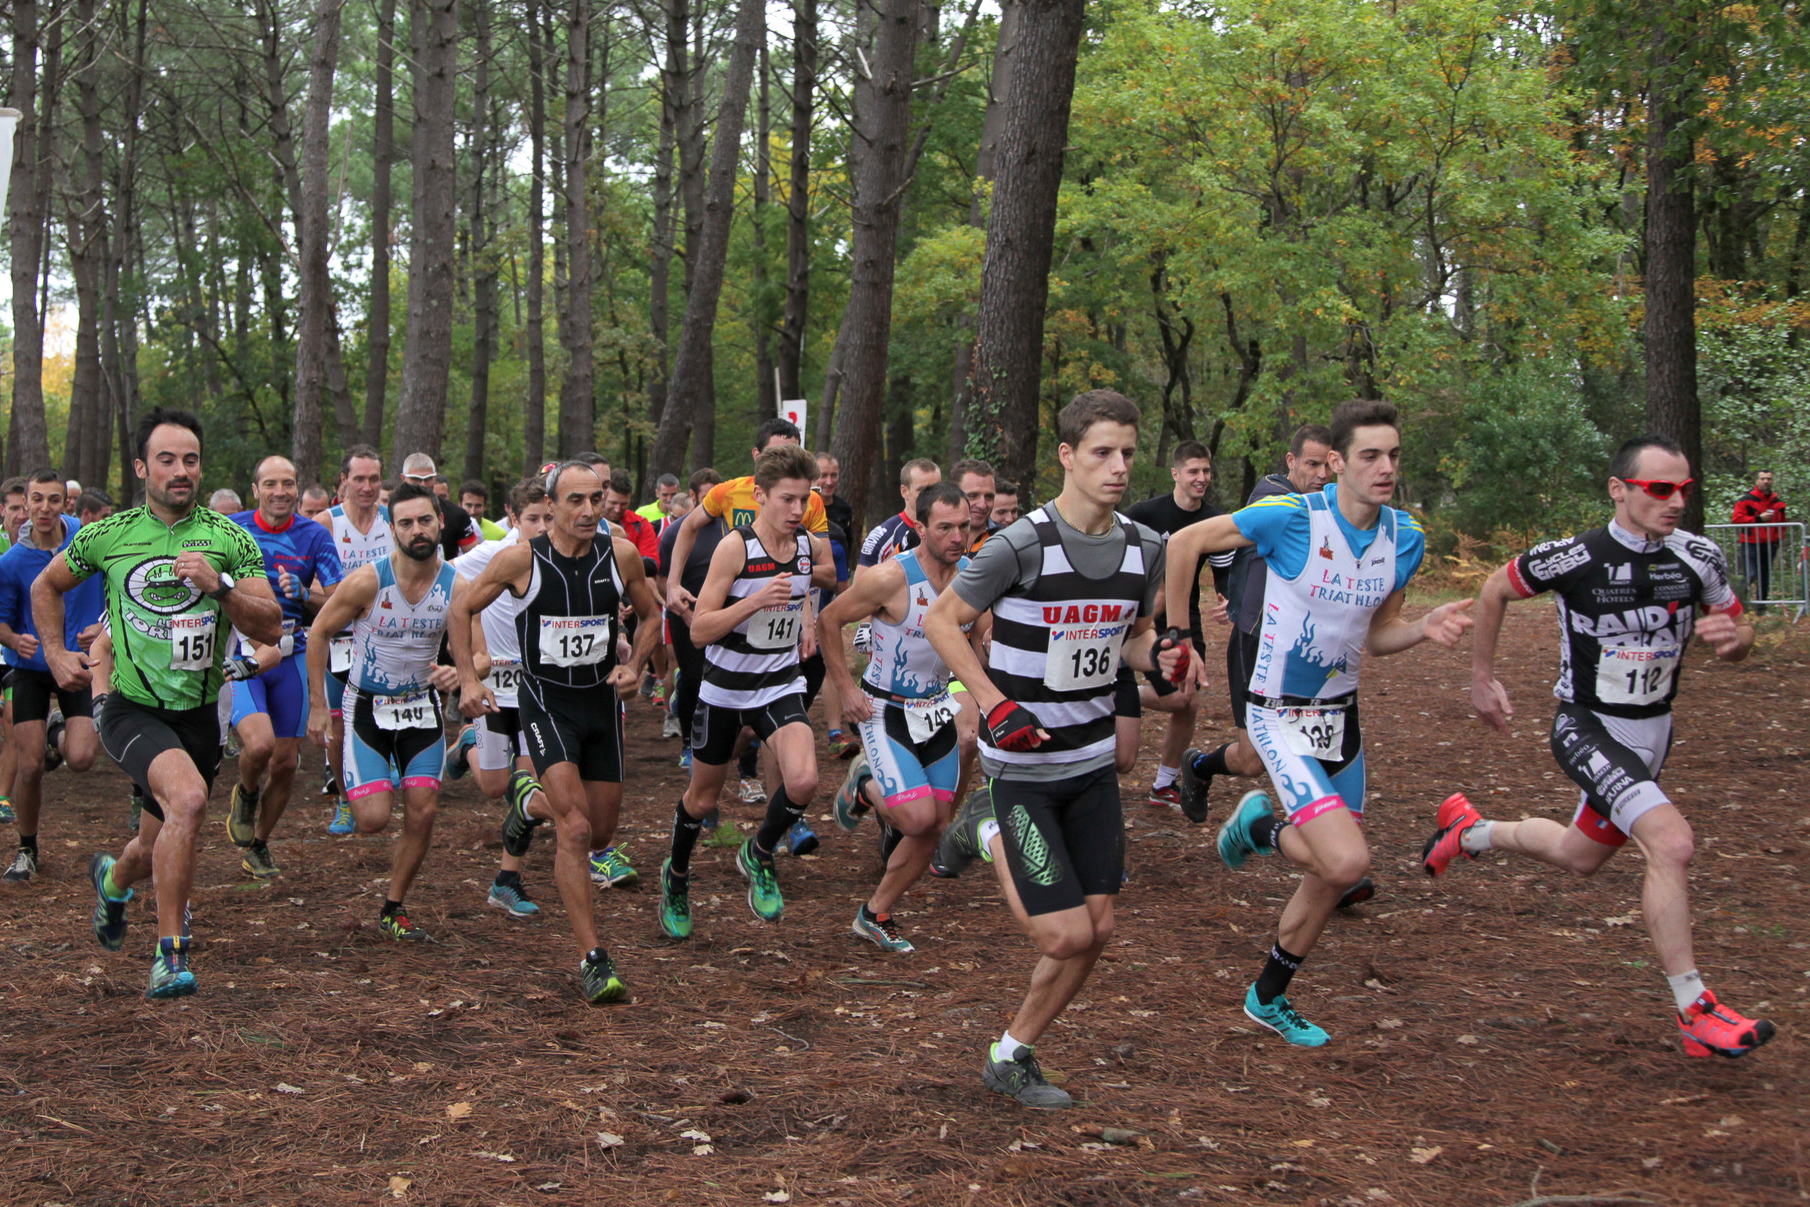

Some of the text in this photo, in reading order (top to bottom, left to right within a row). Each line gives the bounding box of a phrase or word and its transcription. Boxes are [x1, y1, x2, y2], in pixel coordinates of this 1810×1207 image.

[343, 546, 387, 559] LA TESTE
[748, 562, 776, 573] UAGM
[1535, 549, 1592, 581] GABY
[1322, 569, 1386, 593] LA TESTE
[379, 616, 442, 630] LA TESTE
[551, 618, 606, 629] INTERSPORT
[1042, 604, 1122, 624] UAGM
[1267, 602, 1279, 626] LA
[768, 617, 794, 640] 141
[1065, 625, 1125, 641] INTERSPORT
[179, 633, 213, 661] 151
[559, 634, 595, 658] 137
[874, 632, 885, 653] LA
[1072, 647, 1110, 678] 136
[1256, 633, 1276, 683] TESTE
[492, 669, 523, 688] 120
[1626, 666, 1662, 695] 112
[391, 707, 423, 723] 140
[924, 707, 954, 732] 143
[530, 722, 545, 752] CRAFT
